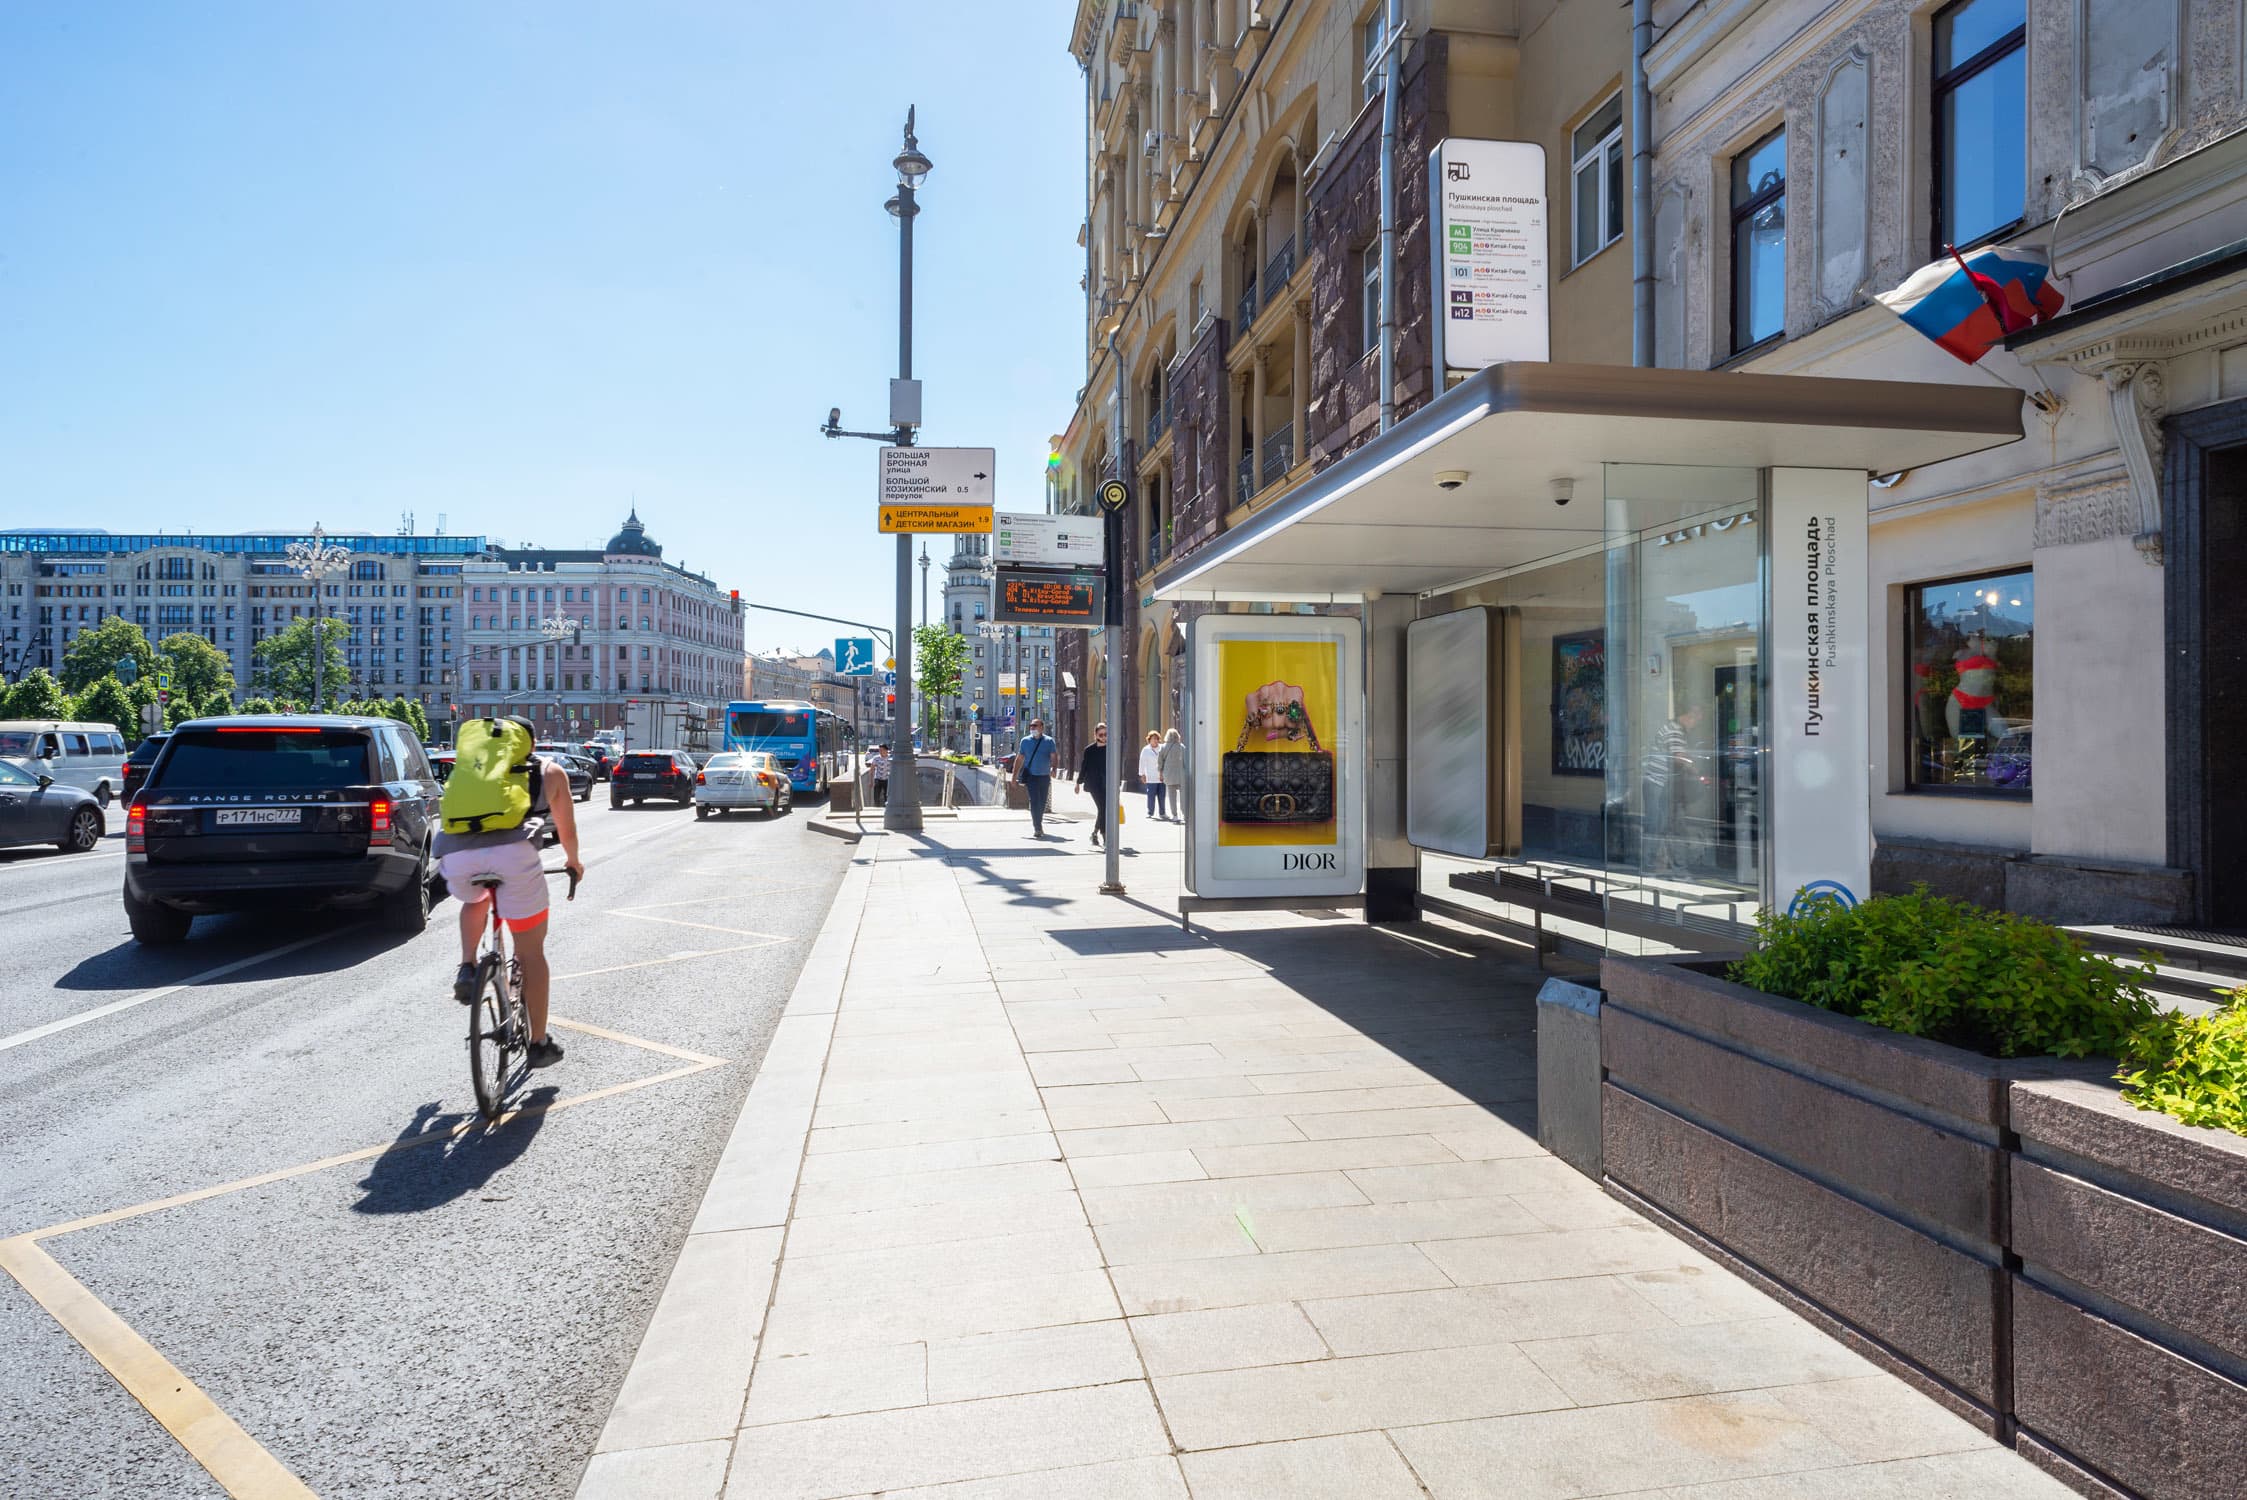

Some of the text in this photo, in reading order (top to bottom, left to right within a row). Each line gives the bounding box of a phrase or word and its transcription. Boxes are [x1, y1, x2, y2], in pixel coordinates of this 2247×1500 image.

[1448, 192, 1540, 205] Пушкинская площадь
[1454, 267, 1468, 277] 101
[886, 451, 930, 459] БОЛЬШАЯ
[886, 459, 928, 467] БРОННАЯ
[886, 477, 930, 485] БОЛЬШОЙ
[885, 485, 947, 493] КОЗИХИНСКИЙ
[896, 510, 959, 518] ЦЕНТРАЛЬНЫЙ
[895, 520, 935, 528] ДЕТСКИЙ
[1824, 517, 1838, 667] Pushkinskaya Ploschad
[1804, 515, 1823, 736] Пушкинская площадь
[1281, 852, 1337, 870] DIOR
